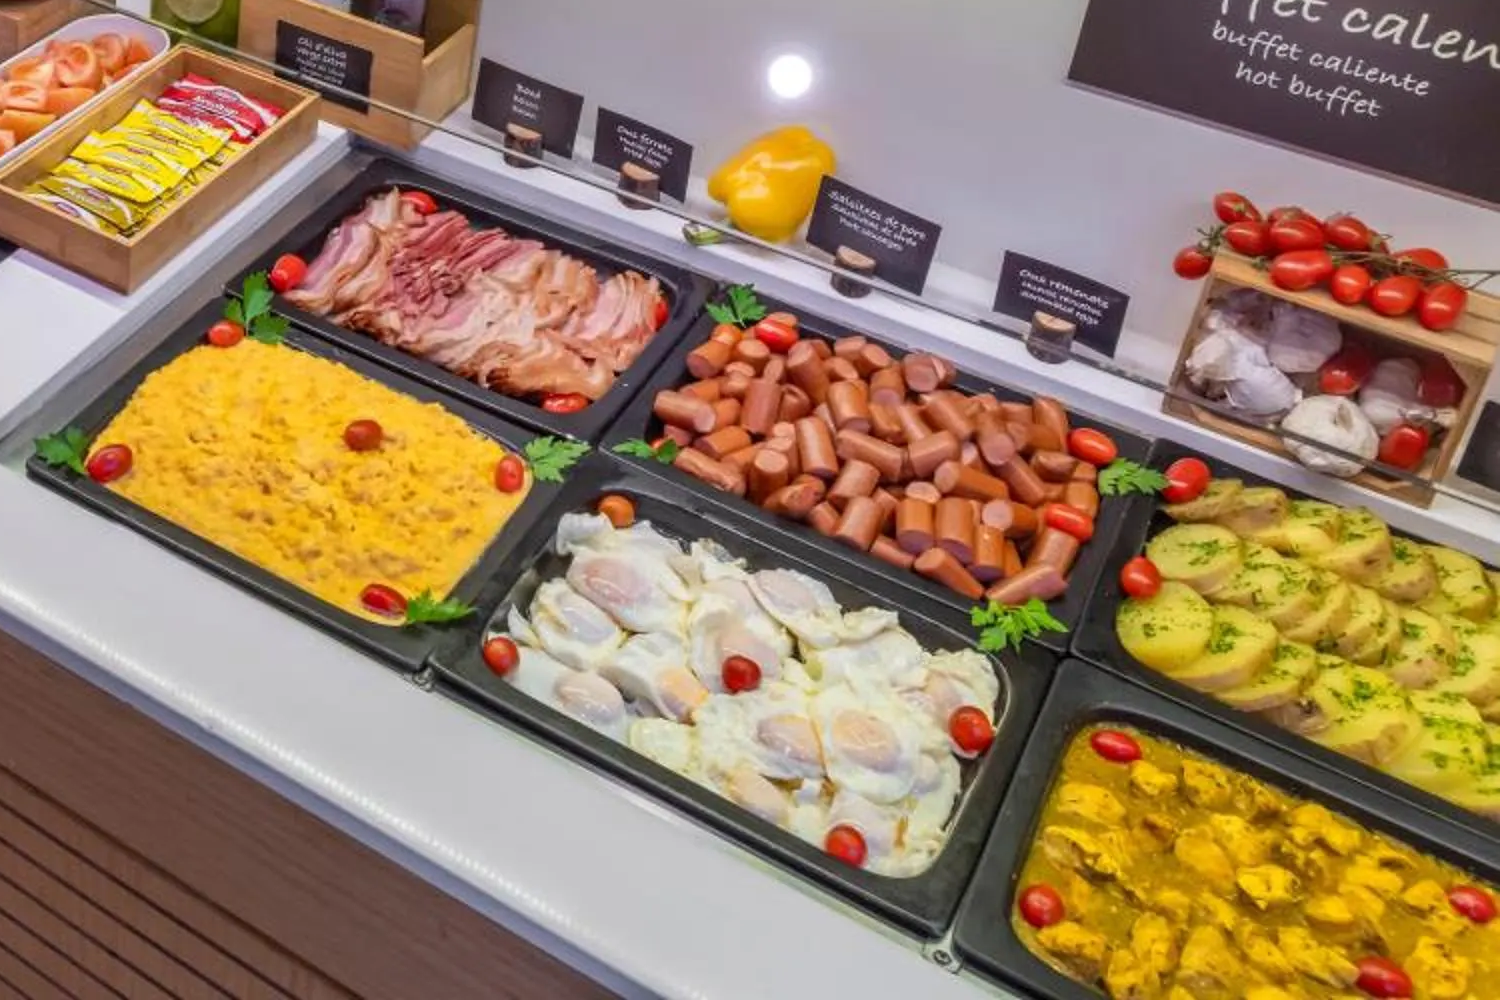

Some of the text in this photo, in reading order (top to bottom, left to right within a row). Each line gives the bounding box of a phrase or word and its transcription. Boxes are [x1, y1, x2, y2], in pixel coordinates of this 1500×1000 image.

[1212, 20, 1430, 97] buffet caliente
[1342, 6, 1500, 69] calen
[1235, 62, 1381, 117] hot buffet
